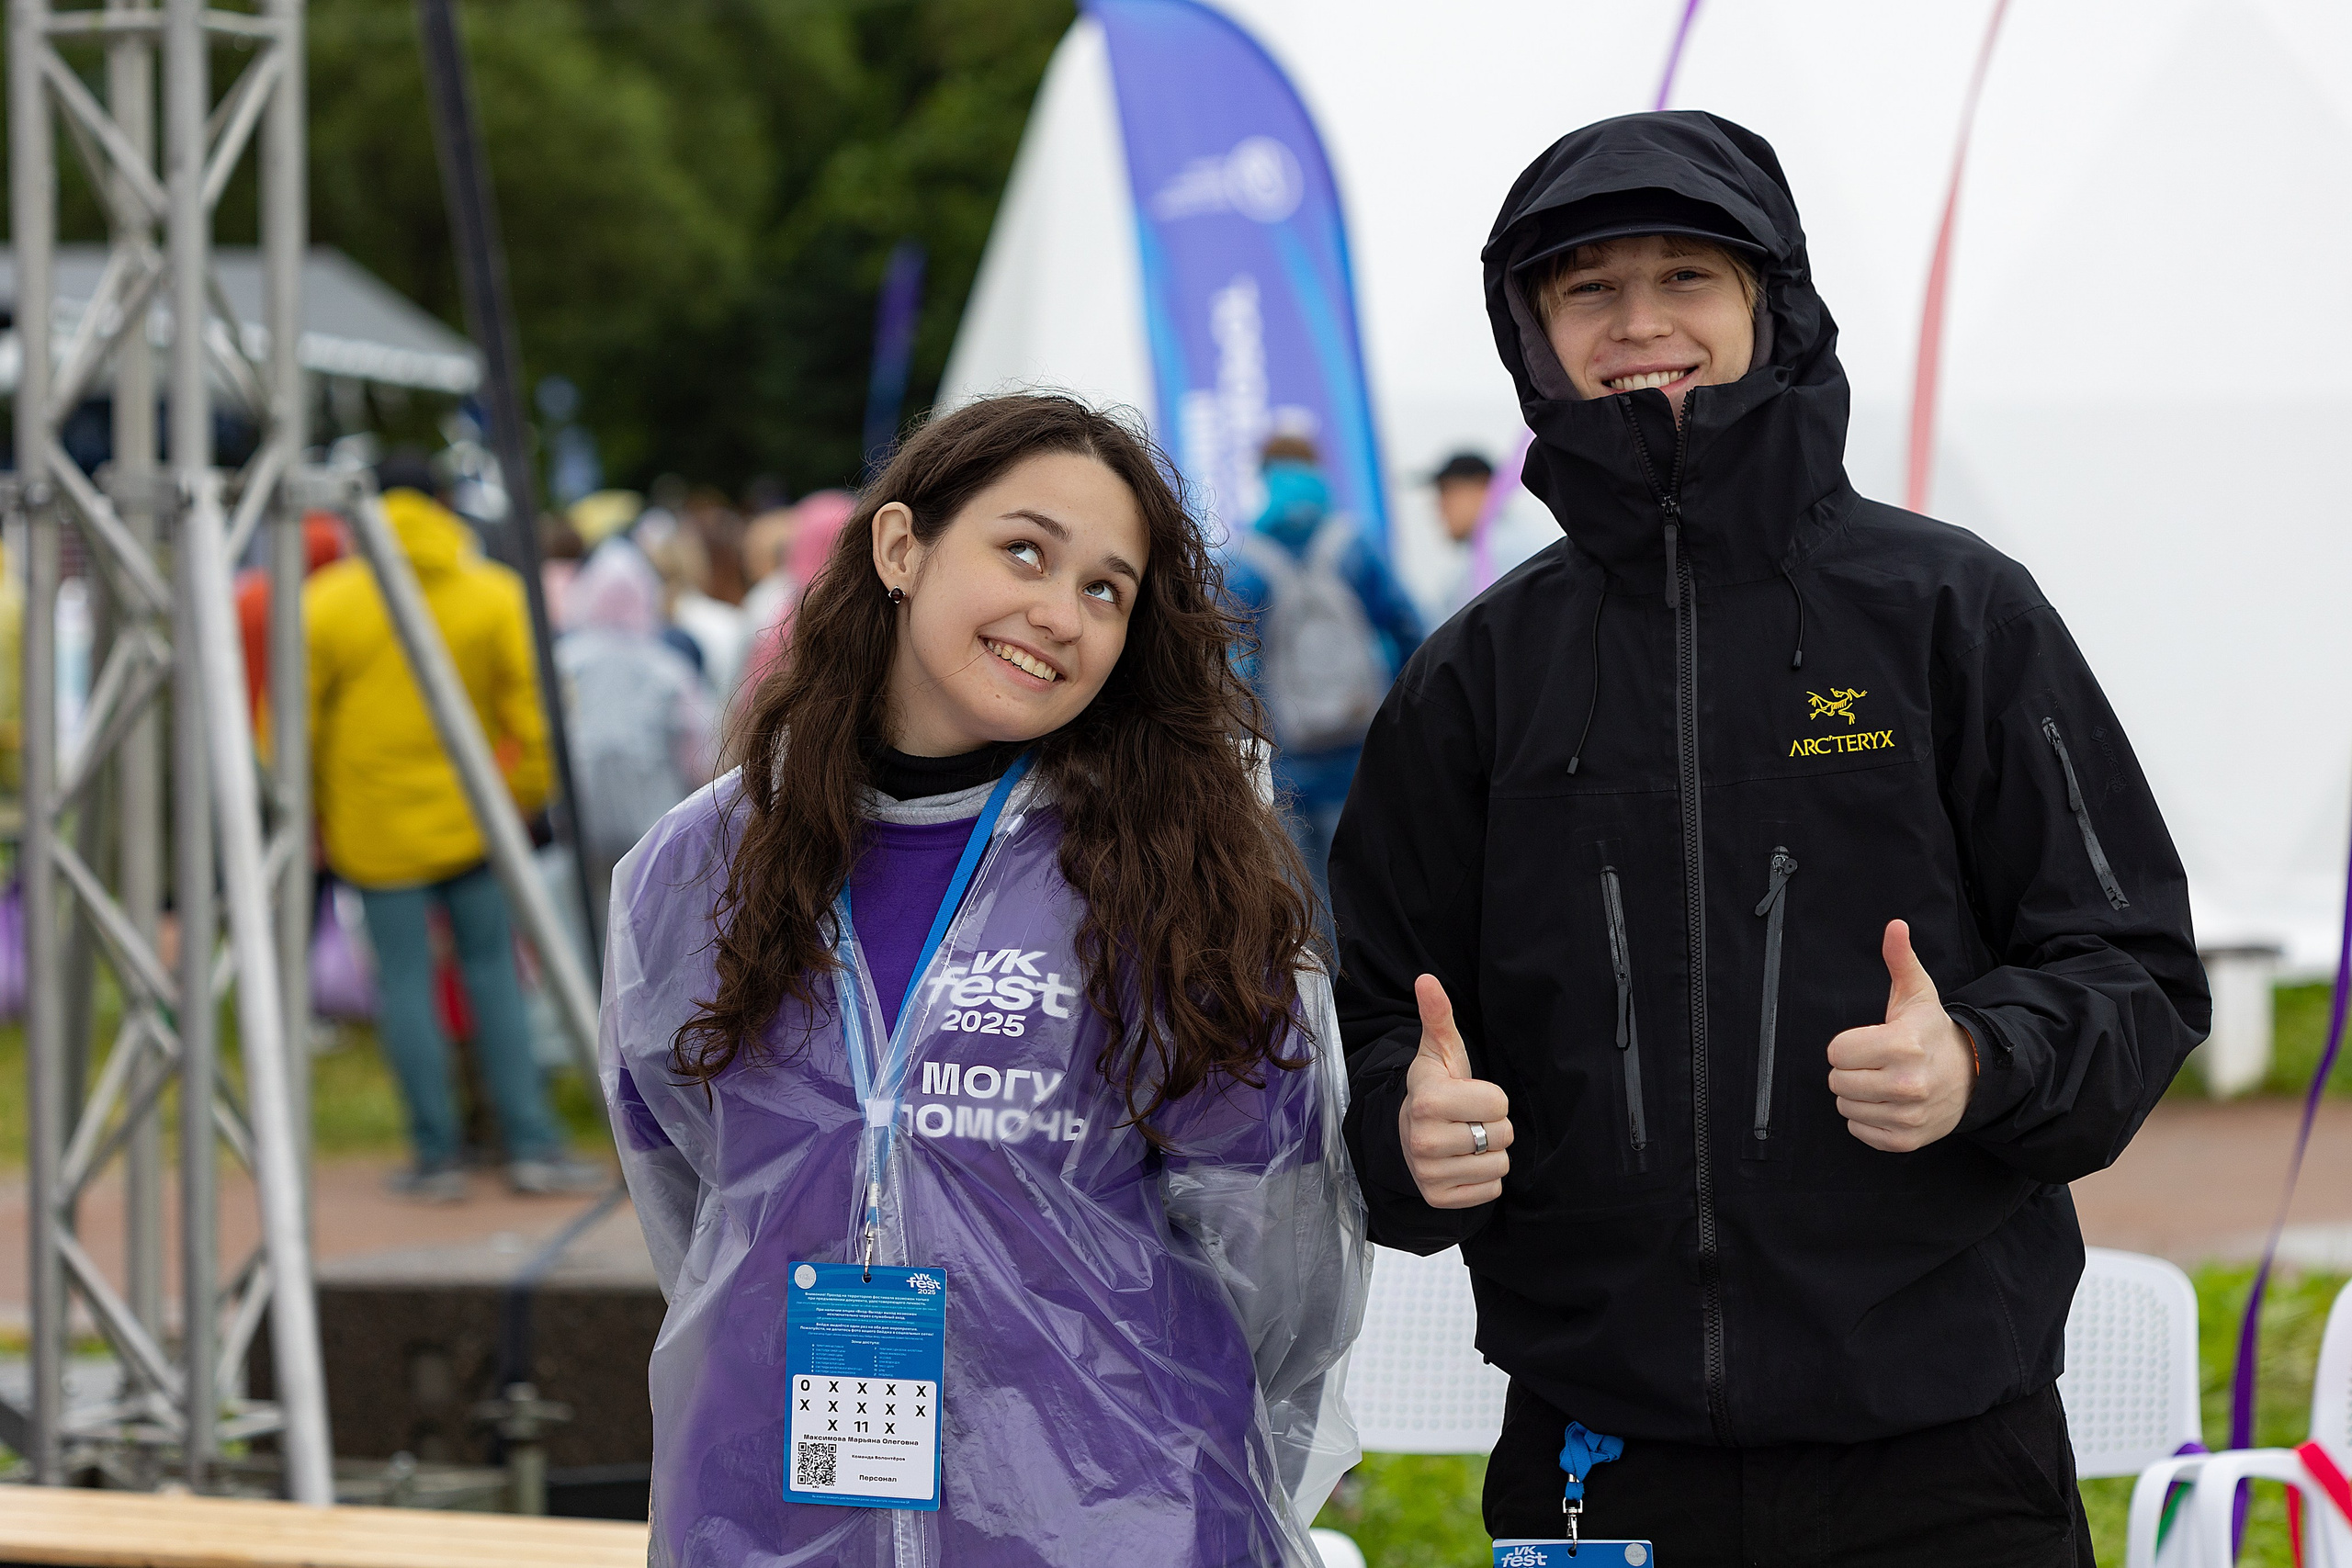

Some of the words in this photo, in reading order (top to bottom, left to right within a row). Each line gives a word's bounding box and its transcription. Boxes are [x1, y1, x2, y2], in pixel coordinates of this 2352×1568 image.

[971, 949, 1047, 977] VK
[927, 966, 1079, 1019] fest
[940, 1010, 1026, 1037] 2025
[922, 1061, 1064, 1102] МОГУ
[906, 1277, 942, 1290] fest
[913, 1272, 933, 1281] VK
[854, 1421, 868, 1433] 11
[804, 1434, 846, 1442] Максимова
[1515, 1546, 1536, 1555] VK
[1500, 1552, 1548, 1567] fest
